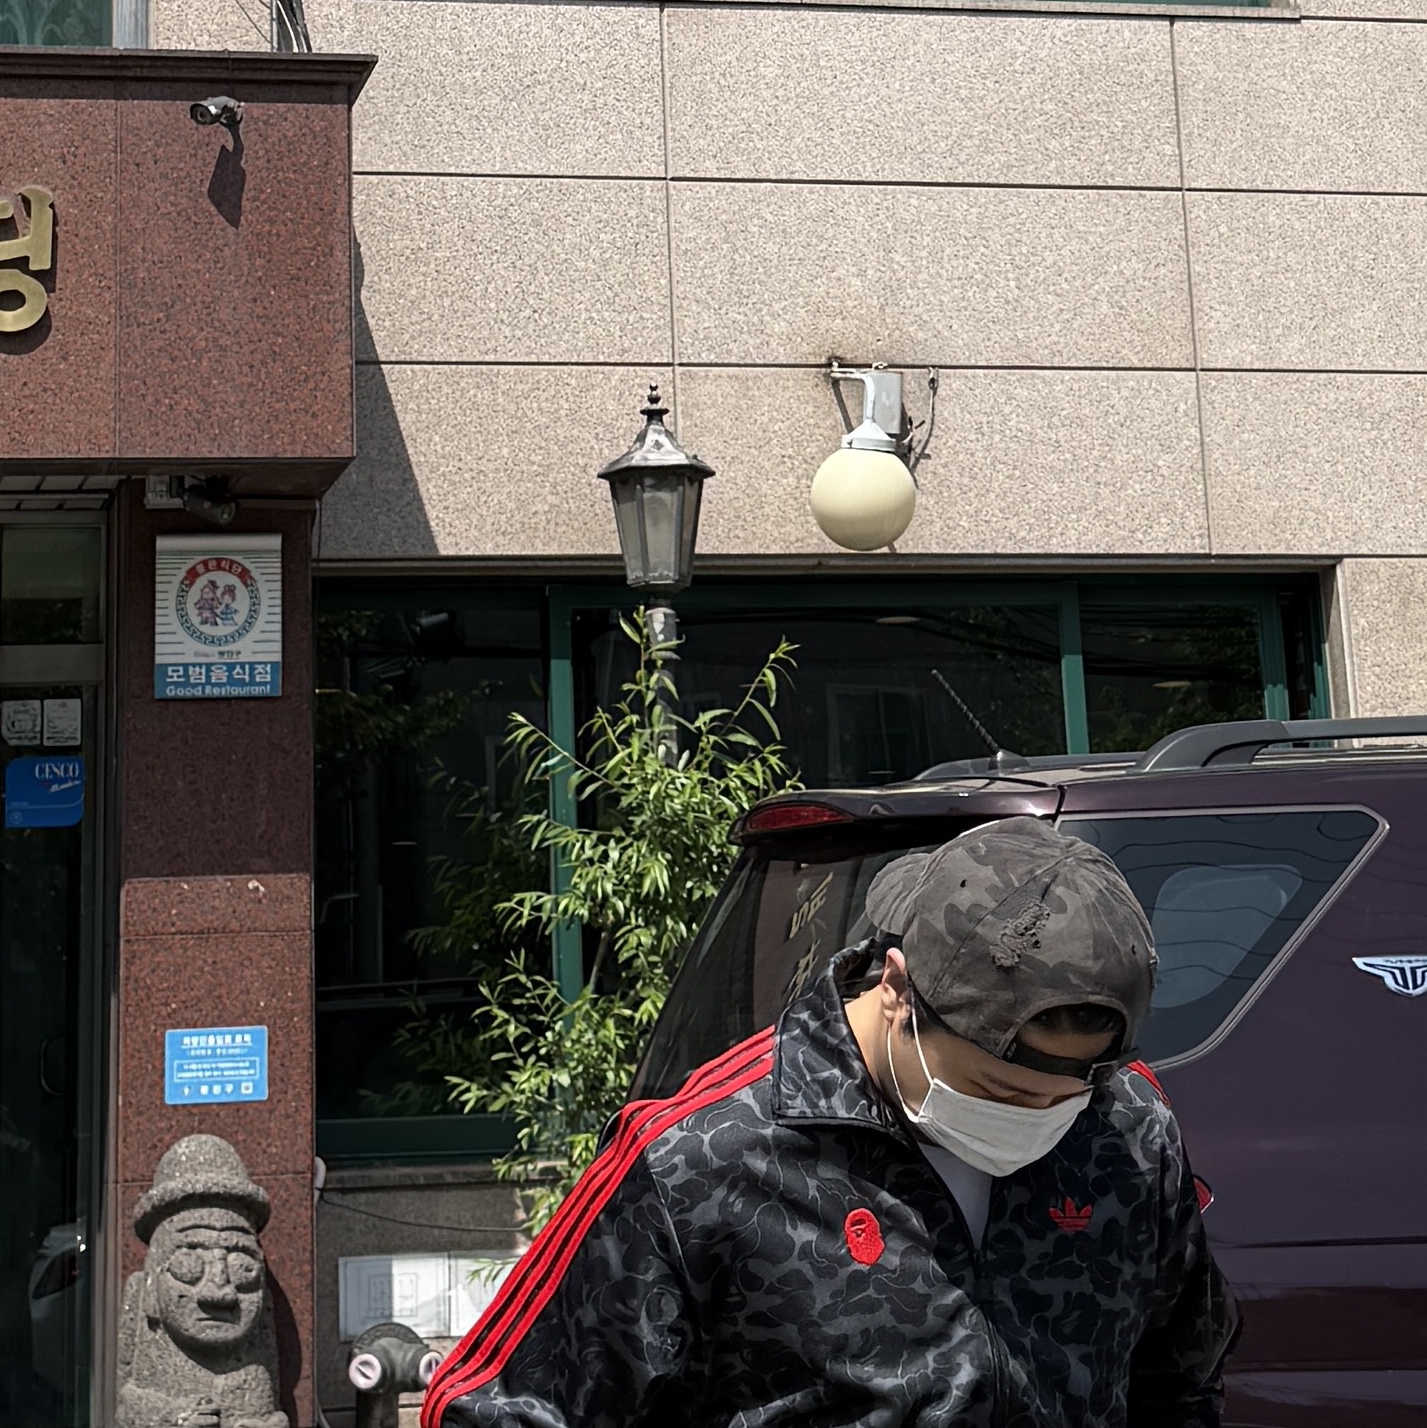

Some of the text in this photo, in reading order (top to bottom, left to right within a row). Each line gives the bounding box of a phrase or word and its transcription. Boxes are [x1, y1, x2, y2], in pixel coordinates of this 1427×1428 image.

[165, 663, 272, 684] 모범음식점
[166, 684, 271, 697] Good Restaurant
[34, 762, 80, 780] CESCO
